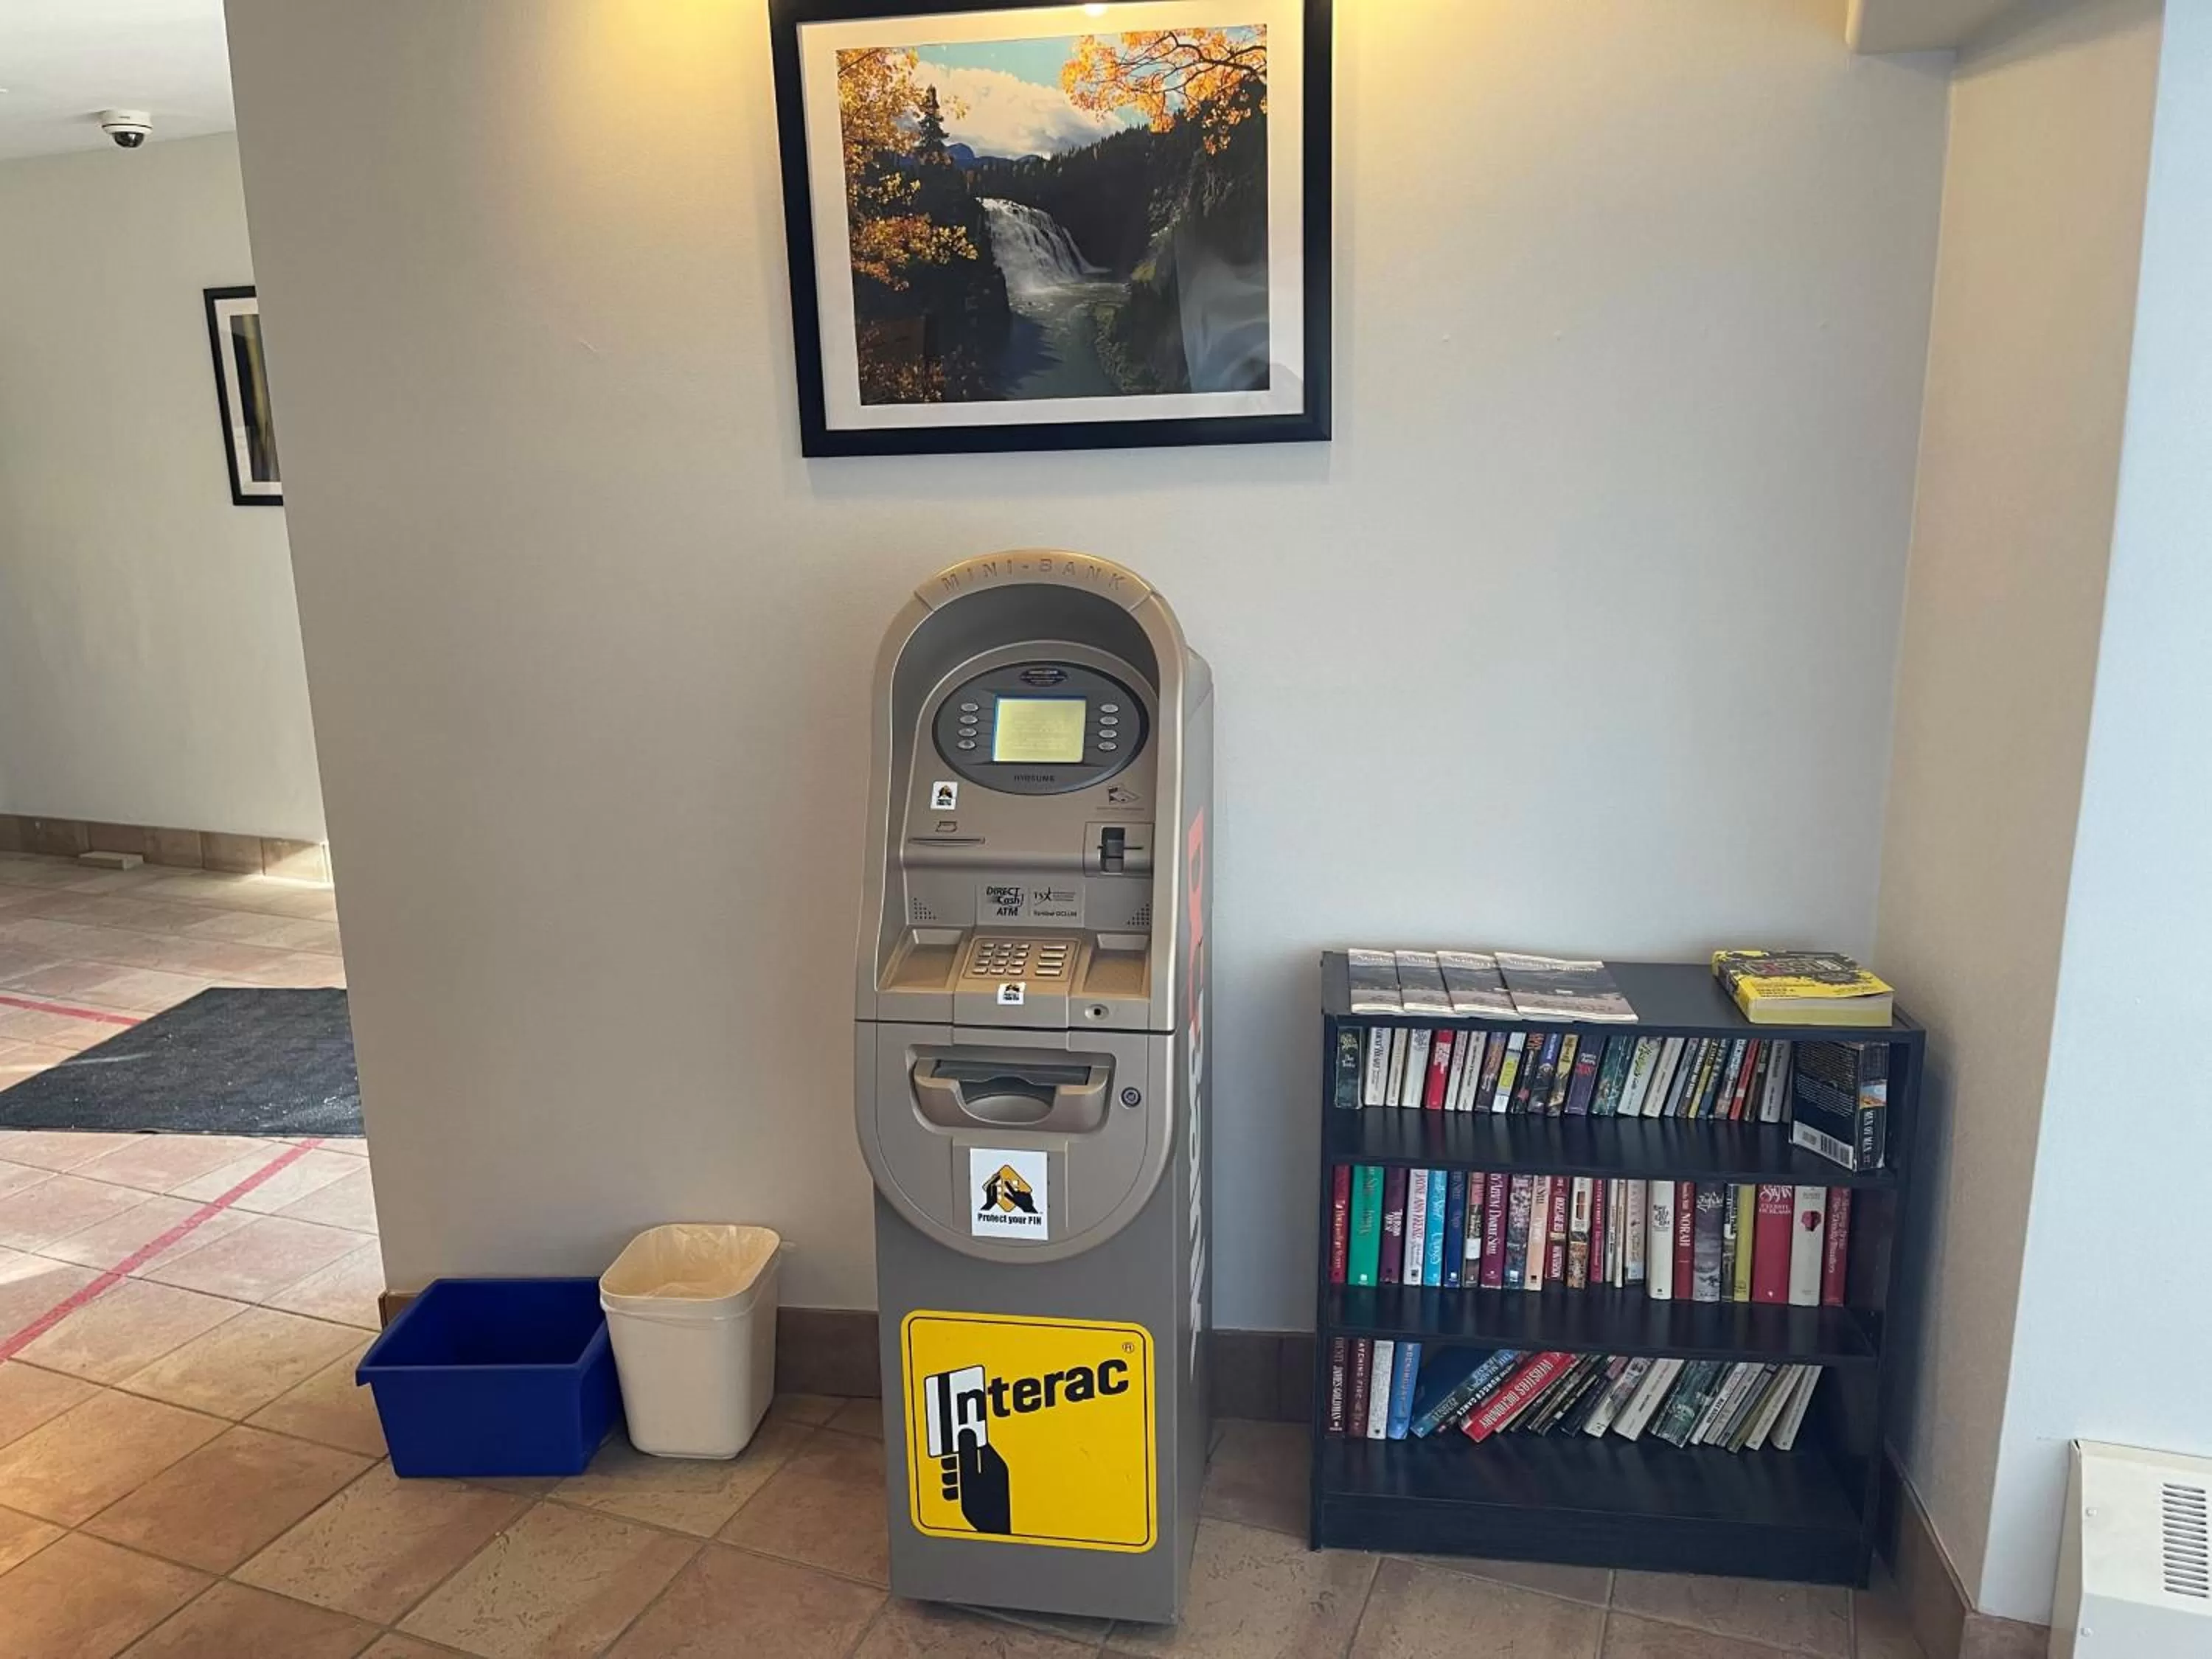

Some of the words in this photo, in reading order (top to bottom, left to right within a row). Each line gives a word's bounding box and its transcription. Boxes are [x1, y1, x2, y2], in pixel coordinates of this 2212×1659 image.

[941, 557, 1127, 591] MINI-BANK
[986, 886, 1021, 896] DIRECT
[997, 895, 1023, 906] Cash
[996, 907, 1018, 917] ATM
[978, 1213, 1007, 1223] Protect
[1008, 1216, 1027, 1225] your
[1028, 1216, 1042, 1225] PIN
[1679, 1212, 1691, 1246] NORAH
[937, 1358, 1130, 1455] Interac
